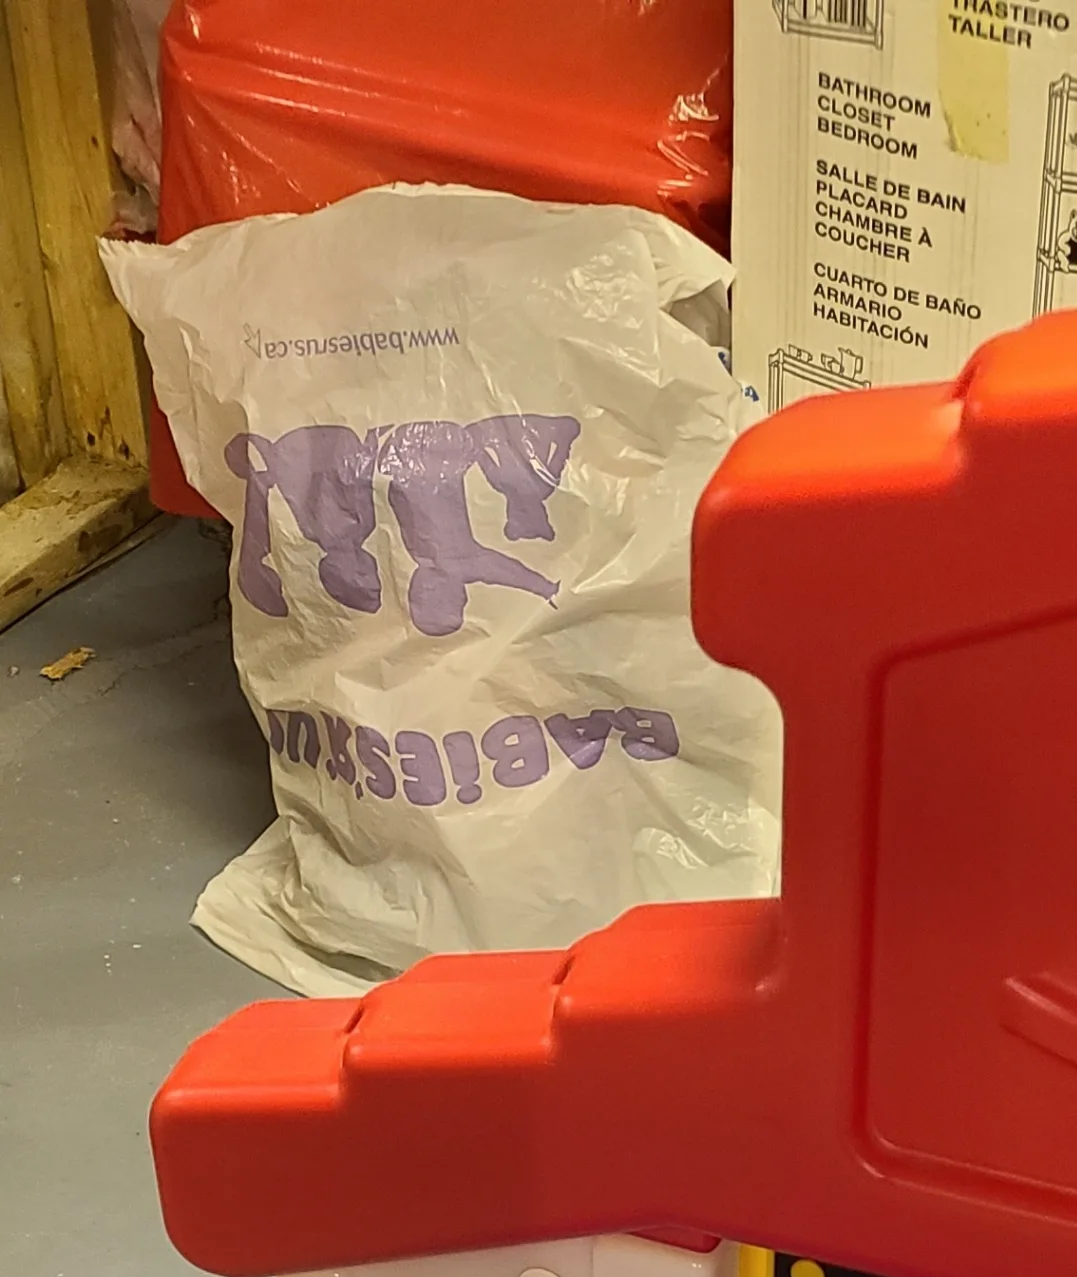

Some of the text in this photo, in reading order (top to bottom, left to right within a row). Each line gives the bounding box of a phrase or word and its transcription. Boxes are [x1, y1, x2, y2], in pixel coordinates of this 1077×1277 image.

[948, 13, 1032, 49] TALLER
[817, 72, 932, 119] BATHROOM
[817, 95, 896, 132] CLOSET
[817, 117, 918, 160] BEDROOM
[816, 159, 967, 215] SALLE DE BAIN
[816, 180, 908, 221] PLACARD
[815, 202, 933, 248] CHAMBRE À
[815, 221, 911, 263] COUCHER
[813, 262, 982, 320] CUARTO DE BAÑO
[813, 282, 902, 321] ARMARIO
[264, 327, 460, 361] www.babiesrus.ca
[813, 302, 929, 349] HABITACIÓN
